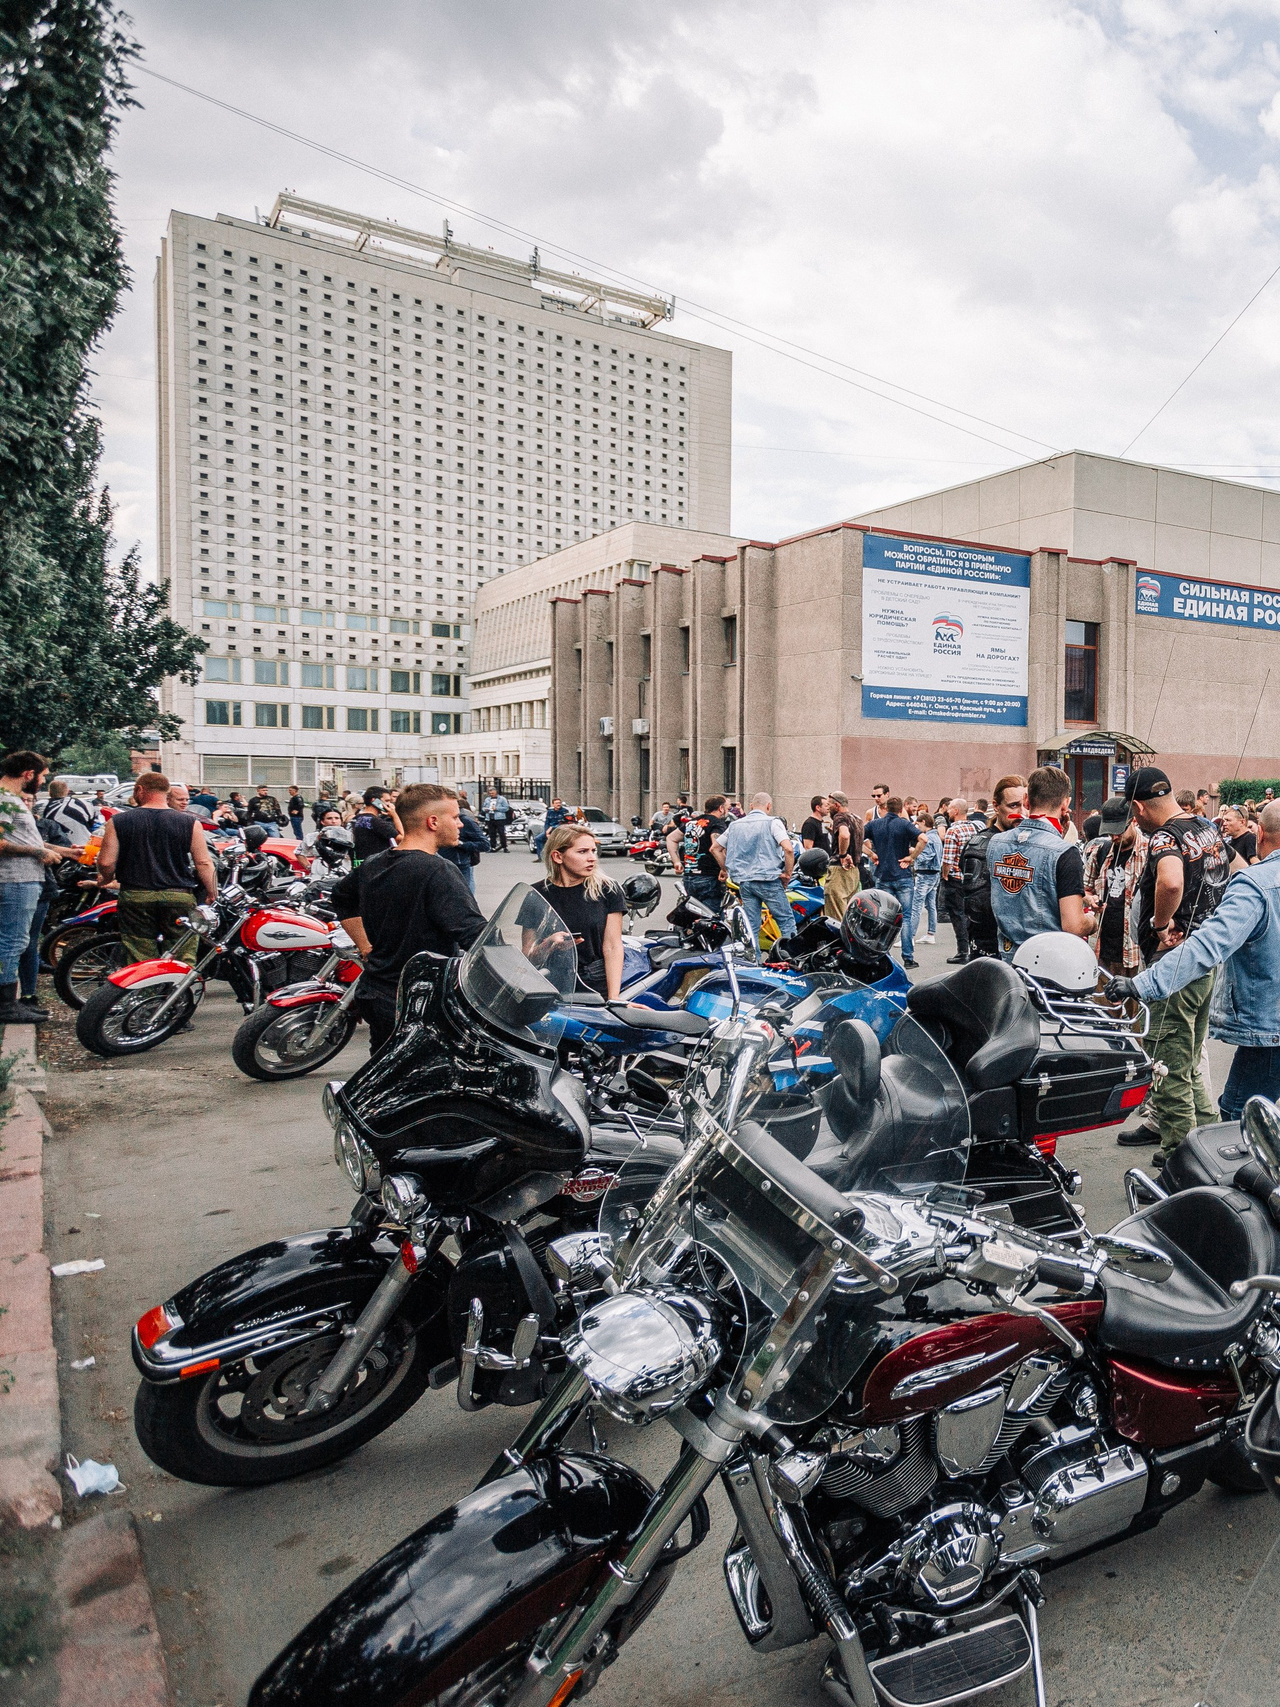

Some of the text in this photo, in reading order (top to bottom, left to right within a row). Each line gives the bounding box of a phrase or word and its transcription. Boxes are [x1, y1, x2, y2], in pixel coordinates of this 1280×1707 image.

[904, 544, 995, 562] ВОПРОСЫ, ПО КОТОРЫМ
[884, 550, 916, 560] МОЖНО
[917, 555, 963, 567] ОБРАТИТЬСЯ
[971, 561, 1011, 573] ПРИЁМНУЮ
[895, 561, 1001, 580] ПАРТИИ «ЕДИНОЙ РОССИИ»:
[947, 586, 988, 596] УПРАВЛЯЮЩЕЙ
[1179, 582, 1250, 603] СИЛЬНАЯ
[1173, 597, 1248, 621] ЕДИНАЯ
[869, 613, 916, 622] ЮРИДИЧЕСКАЯ
[996, 866, 1030, 879] HARLEY-DAVIDSON
[558, 1181, 620, 1195] DAVIDSON
[564, 1176, 610, 1187] HARLEY
